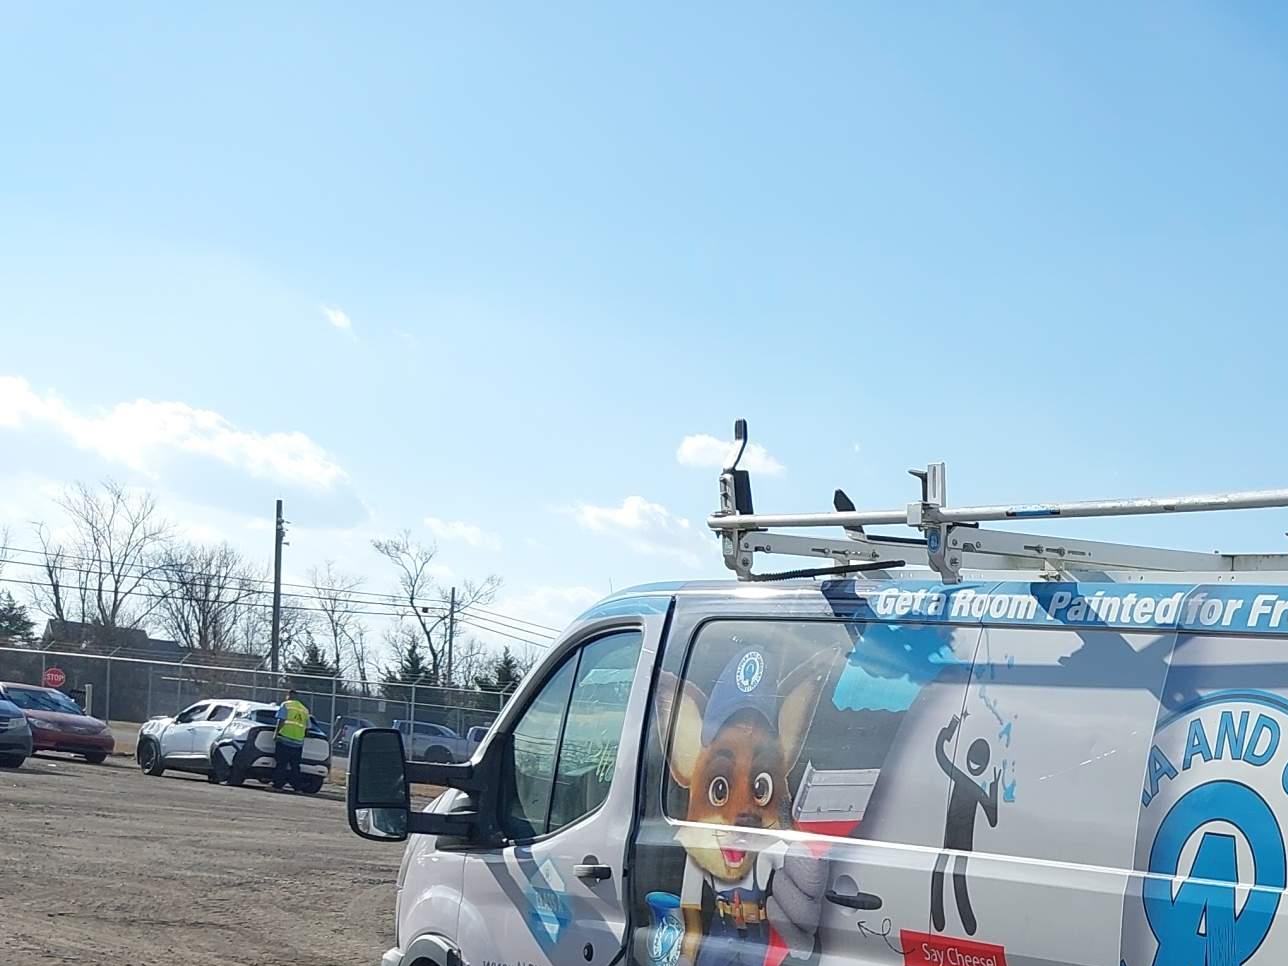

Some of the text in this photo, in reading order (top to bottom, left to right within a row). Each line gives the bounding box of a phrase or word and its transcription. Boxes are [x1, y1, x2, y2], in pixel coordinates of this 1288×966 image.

[876, 588, 927, 615] Get
[927, 593, 946, 616] a
[951, 589, 1038, 620] Room
[1047, 590, 1185, 625] Painted
[1185, 592, 1243, 626] for
[46, 673, 64, 681] STOP
[1182, 710, 1281, 771] AND
